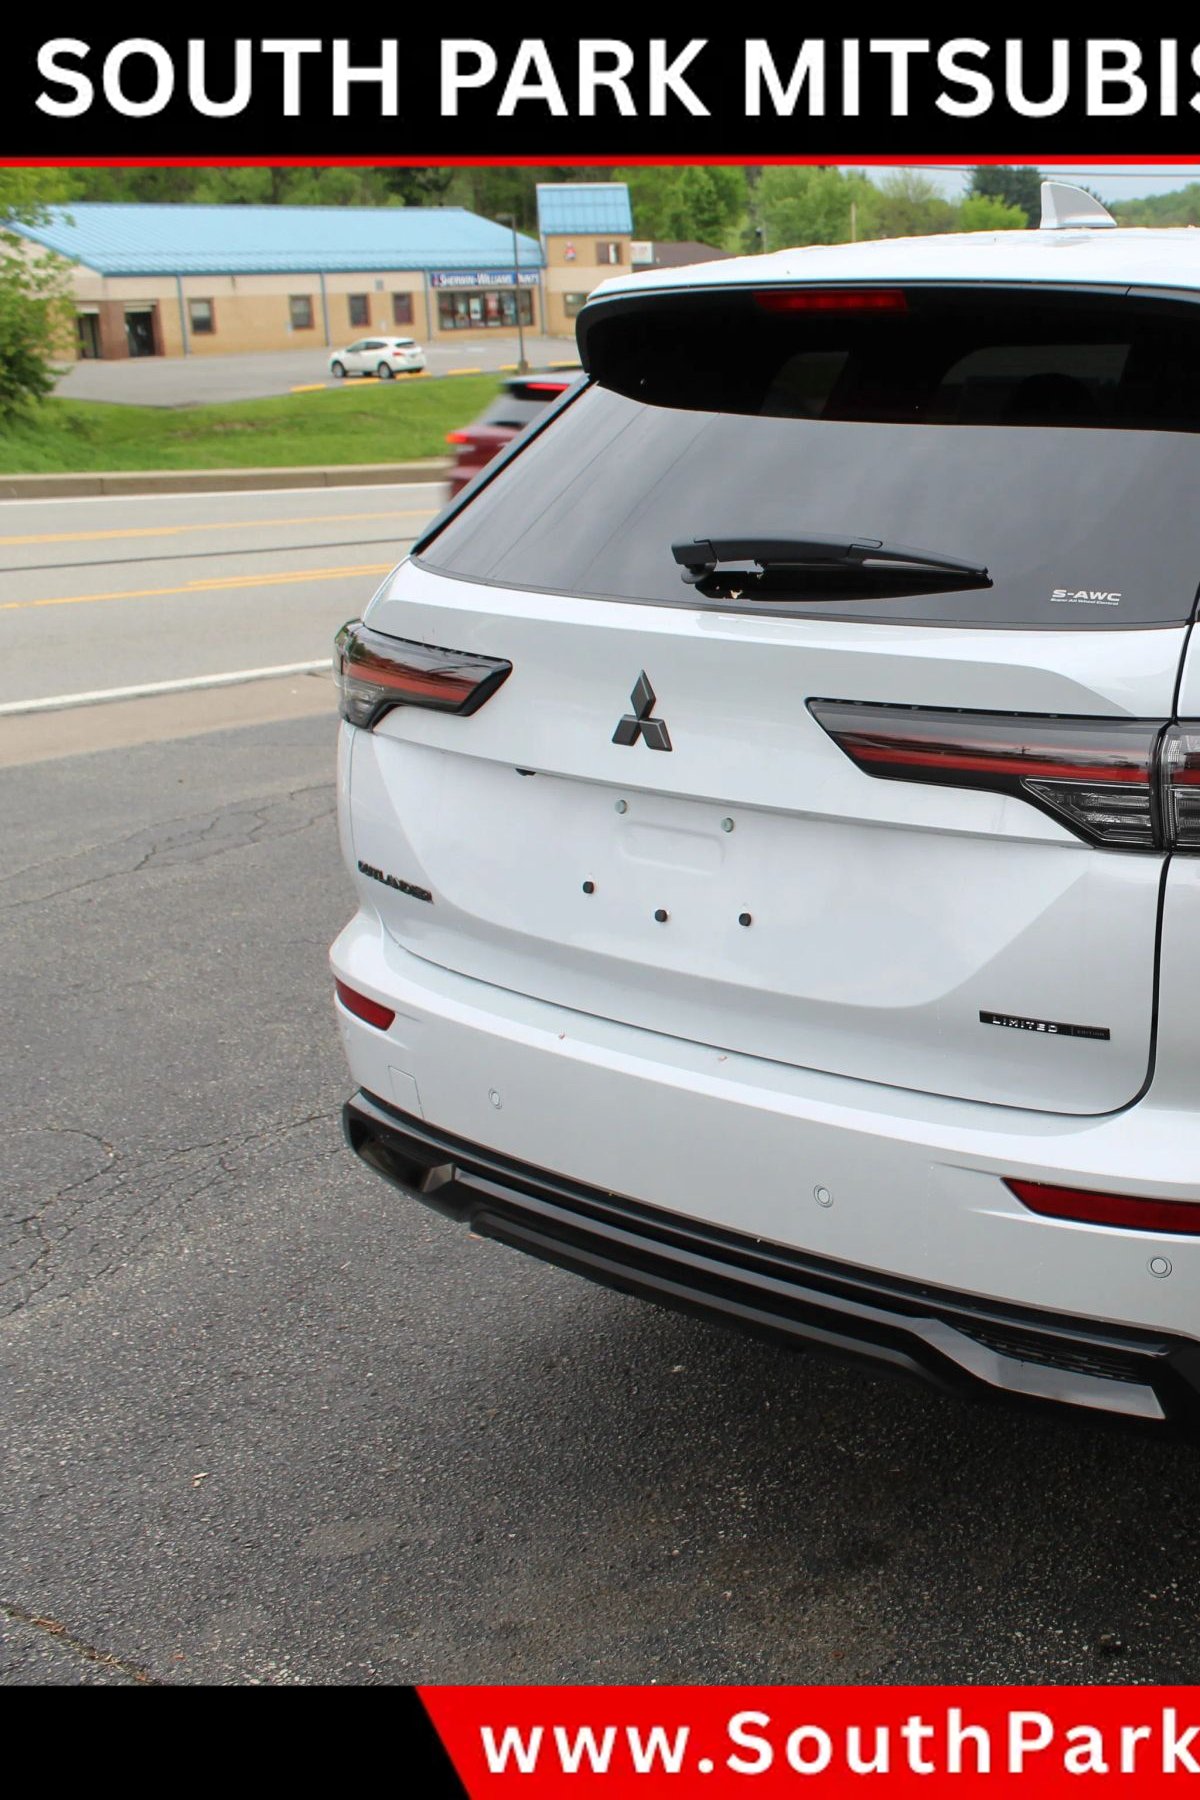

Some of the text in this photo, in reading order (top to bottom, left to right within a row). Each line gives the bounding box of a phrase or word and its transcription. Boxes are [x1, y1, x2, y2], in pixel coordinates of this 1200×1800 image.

[1052, 589, 1121, 602] S-AWC
[358, 860, 433, 904] OUTLANDER
[992, 1015, 1058, 1033] LIMITED
